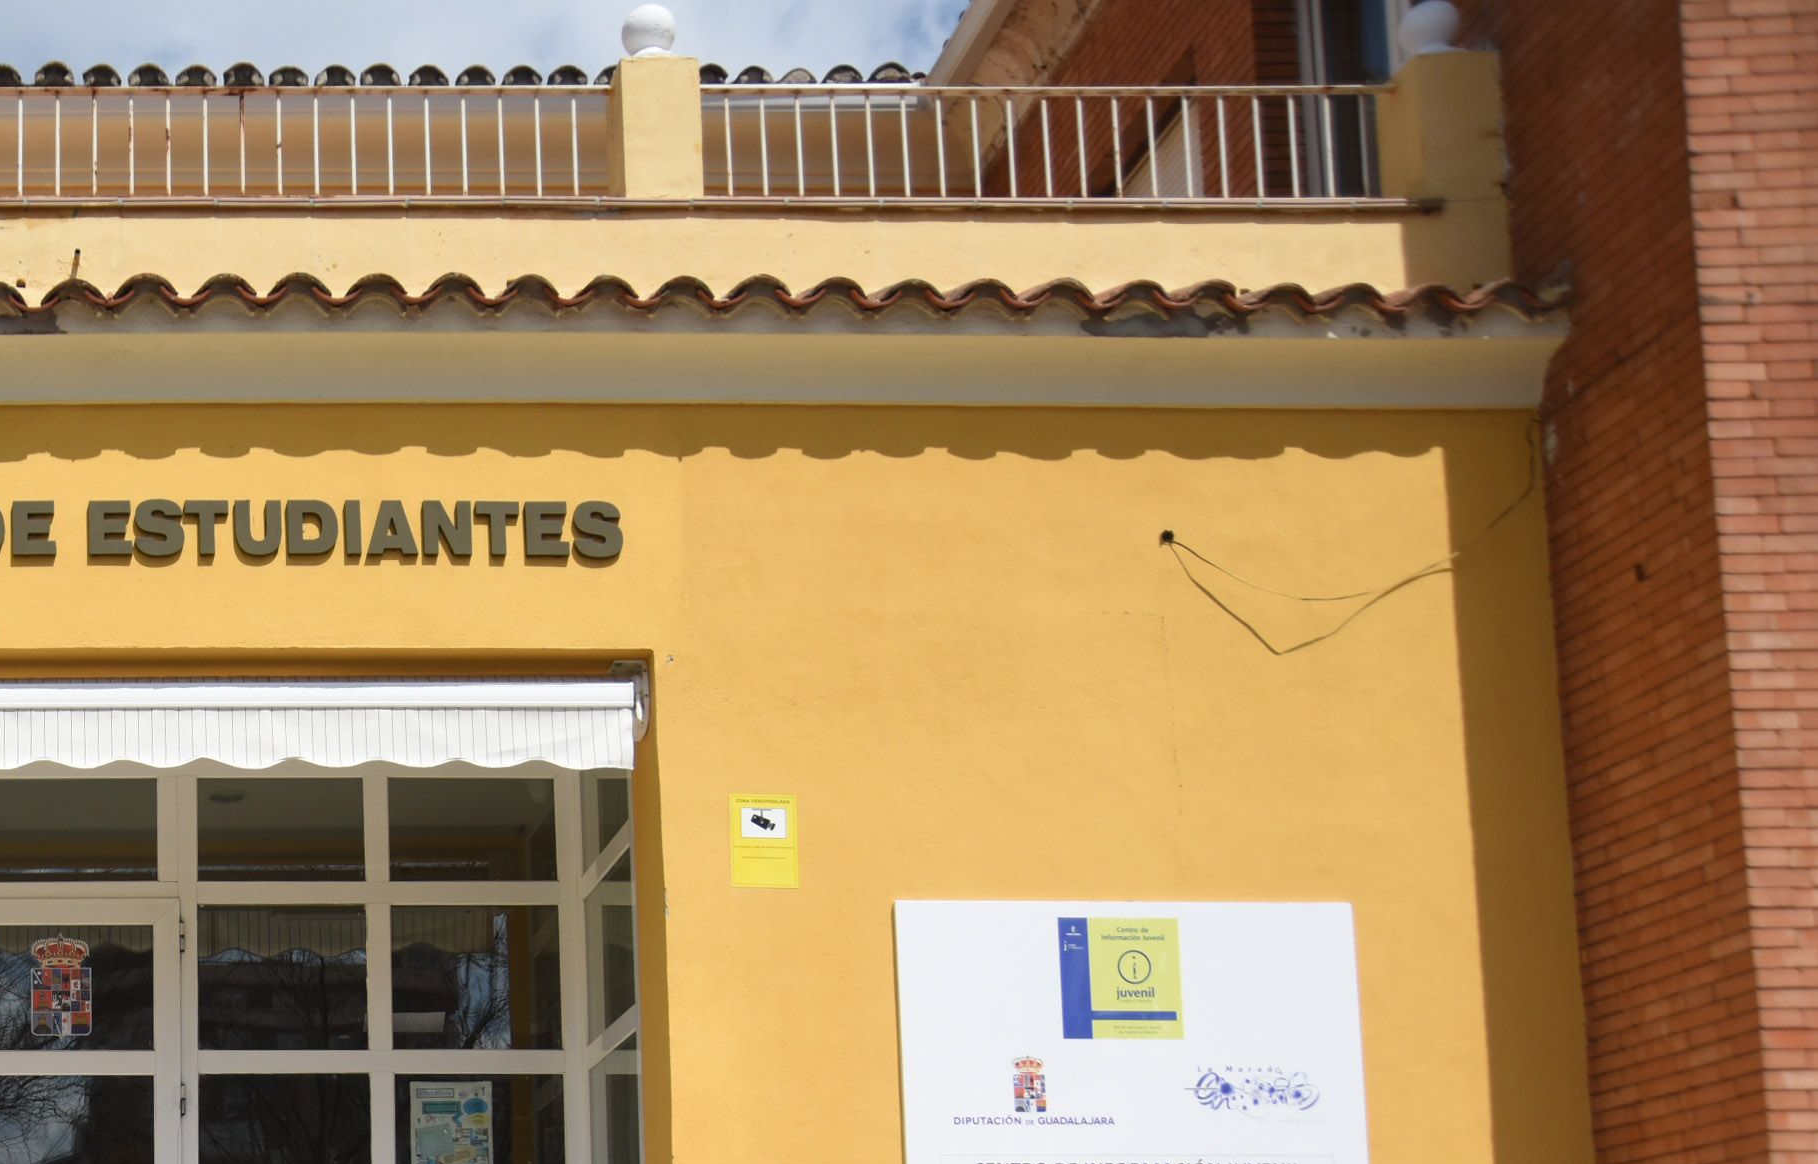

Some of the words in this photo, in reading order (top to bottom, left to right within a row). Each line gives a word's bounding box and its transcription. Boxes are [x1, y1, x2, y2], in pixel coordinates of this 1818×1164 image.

[87, 499, 623, 560] ESTUDIANTES
[1116, 987, 1155, 1000] juvenil
[953, 1115, 1022, 1125] DIPUTACIÓN
[1037, 1116, 1115, 1125] GUADALAJARA
